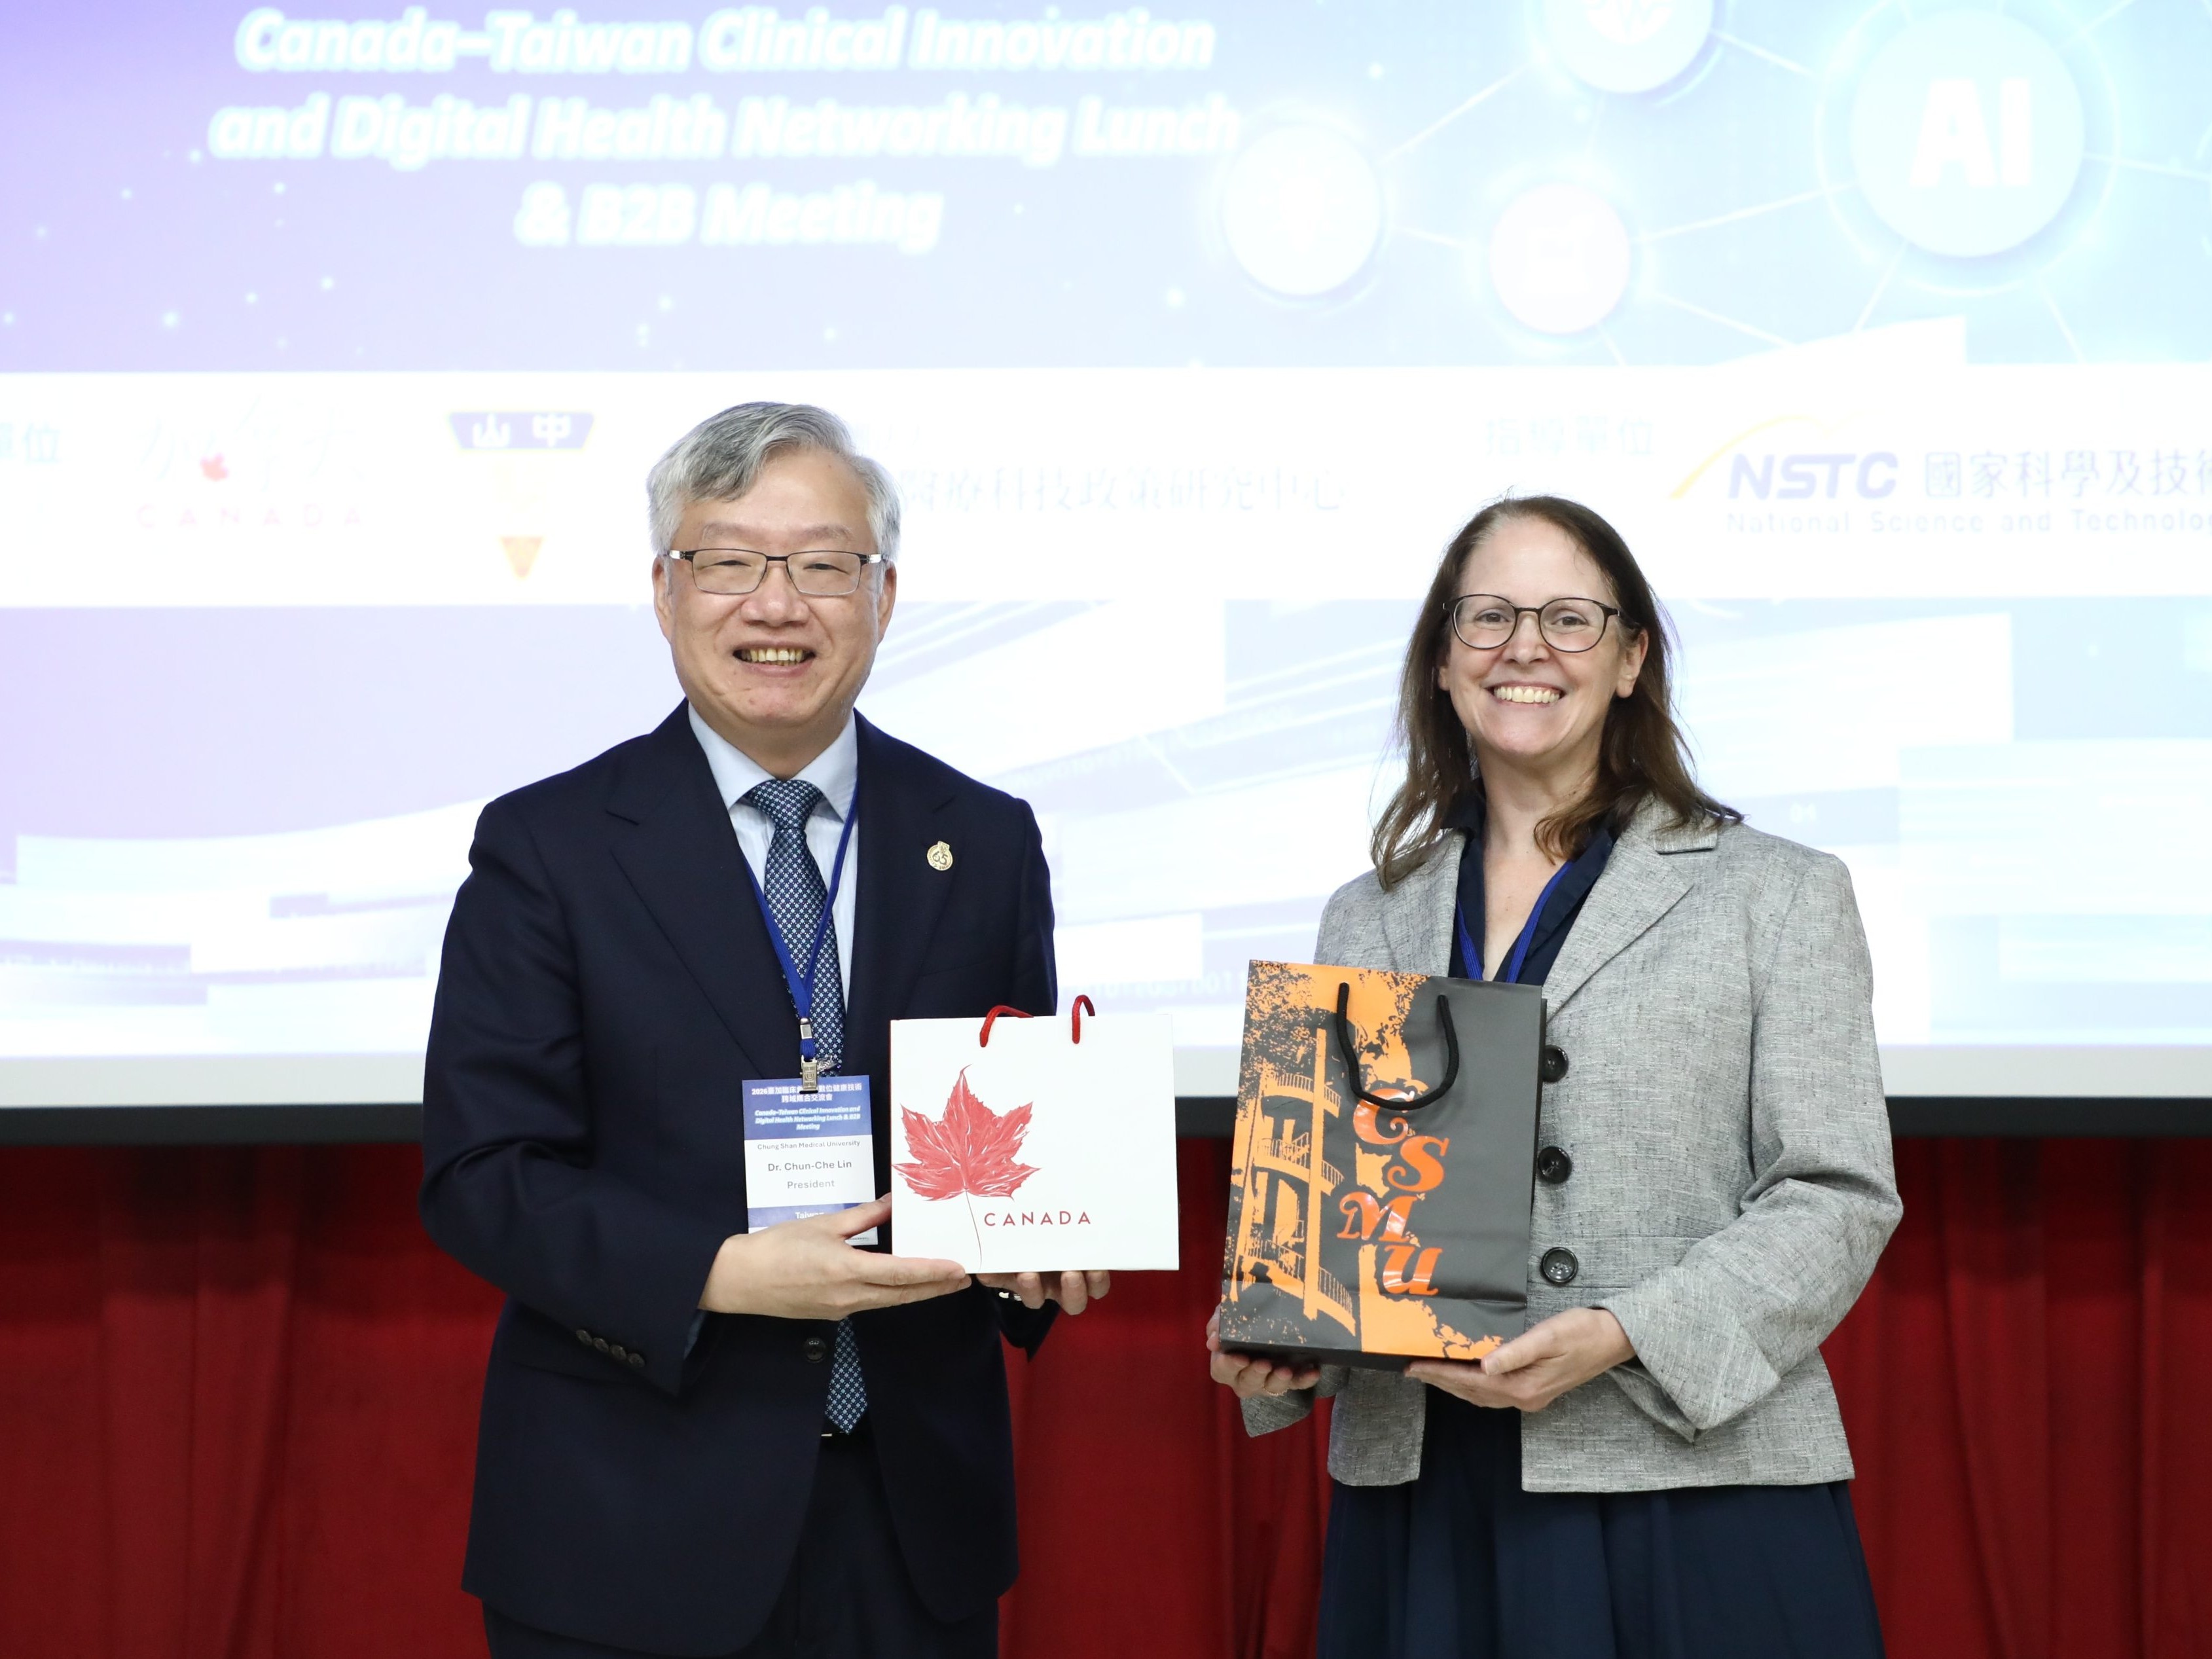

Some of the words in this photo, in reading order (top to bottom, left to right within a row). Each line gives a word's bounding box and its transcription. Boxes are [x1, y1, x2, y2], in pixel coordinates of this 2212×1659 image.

[703, 5, 906, 69] Clinical
[913, 7, 1215, 69] Innovation
[212, 94, 329, 157] and
[335, 95, 531, 170] Digital
[535, 95, 727, 158] Health
[734, 94, 1066, 166] Networking
[1076, 92, 1240, 155] Lunch
[1910, 77, 2031, 187] AI
[517, 181, 571, 246] &
[579, 183, 697, 245] B2B
[703, 181, 943, 253] Meeting
[1727, 450, 1899, 500] NSTC
[136, 502, 364, 530] CANADA
[1726, 509, 1849, 534] National
[1870, 510, 1984, 534] Science
[1999, 509, 2052, 533] and
[784, 1161, 835, 1171] Chun-Che
[837, 1160, 852, 1169] Lin
[787, 1180, 835, 1190] President
[984, 1211, 1091, 1227] CANADA
